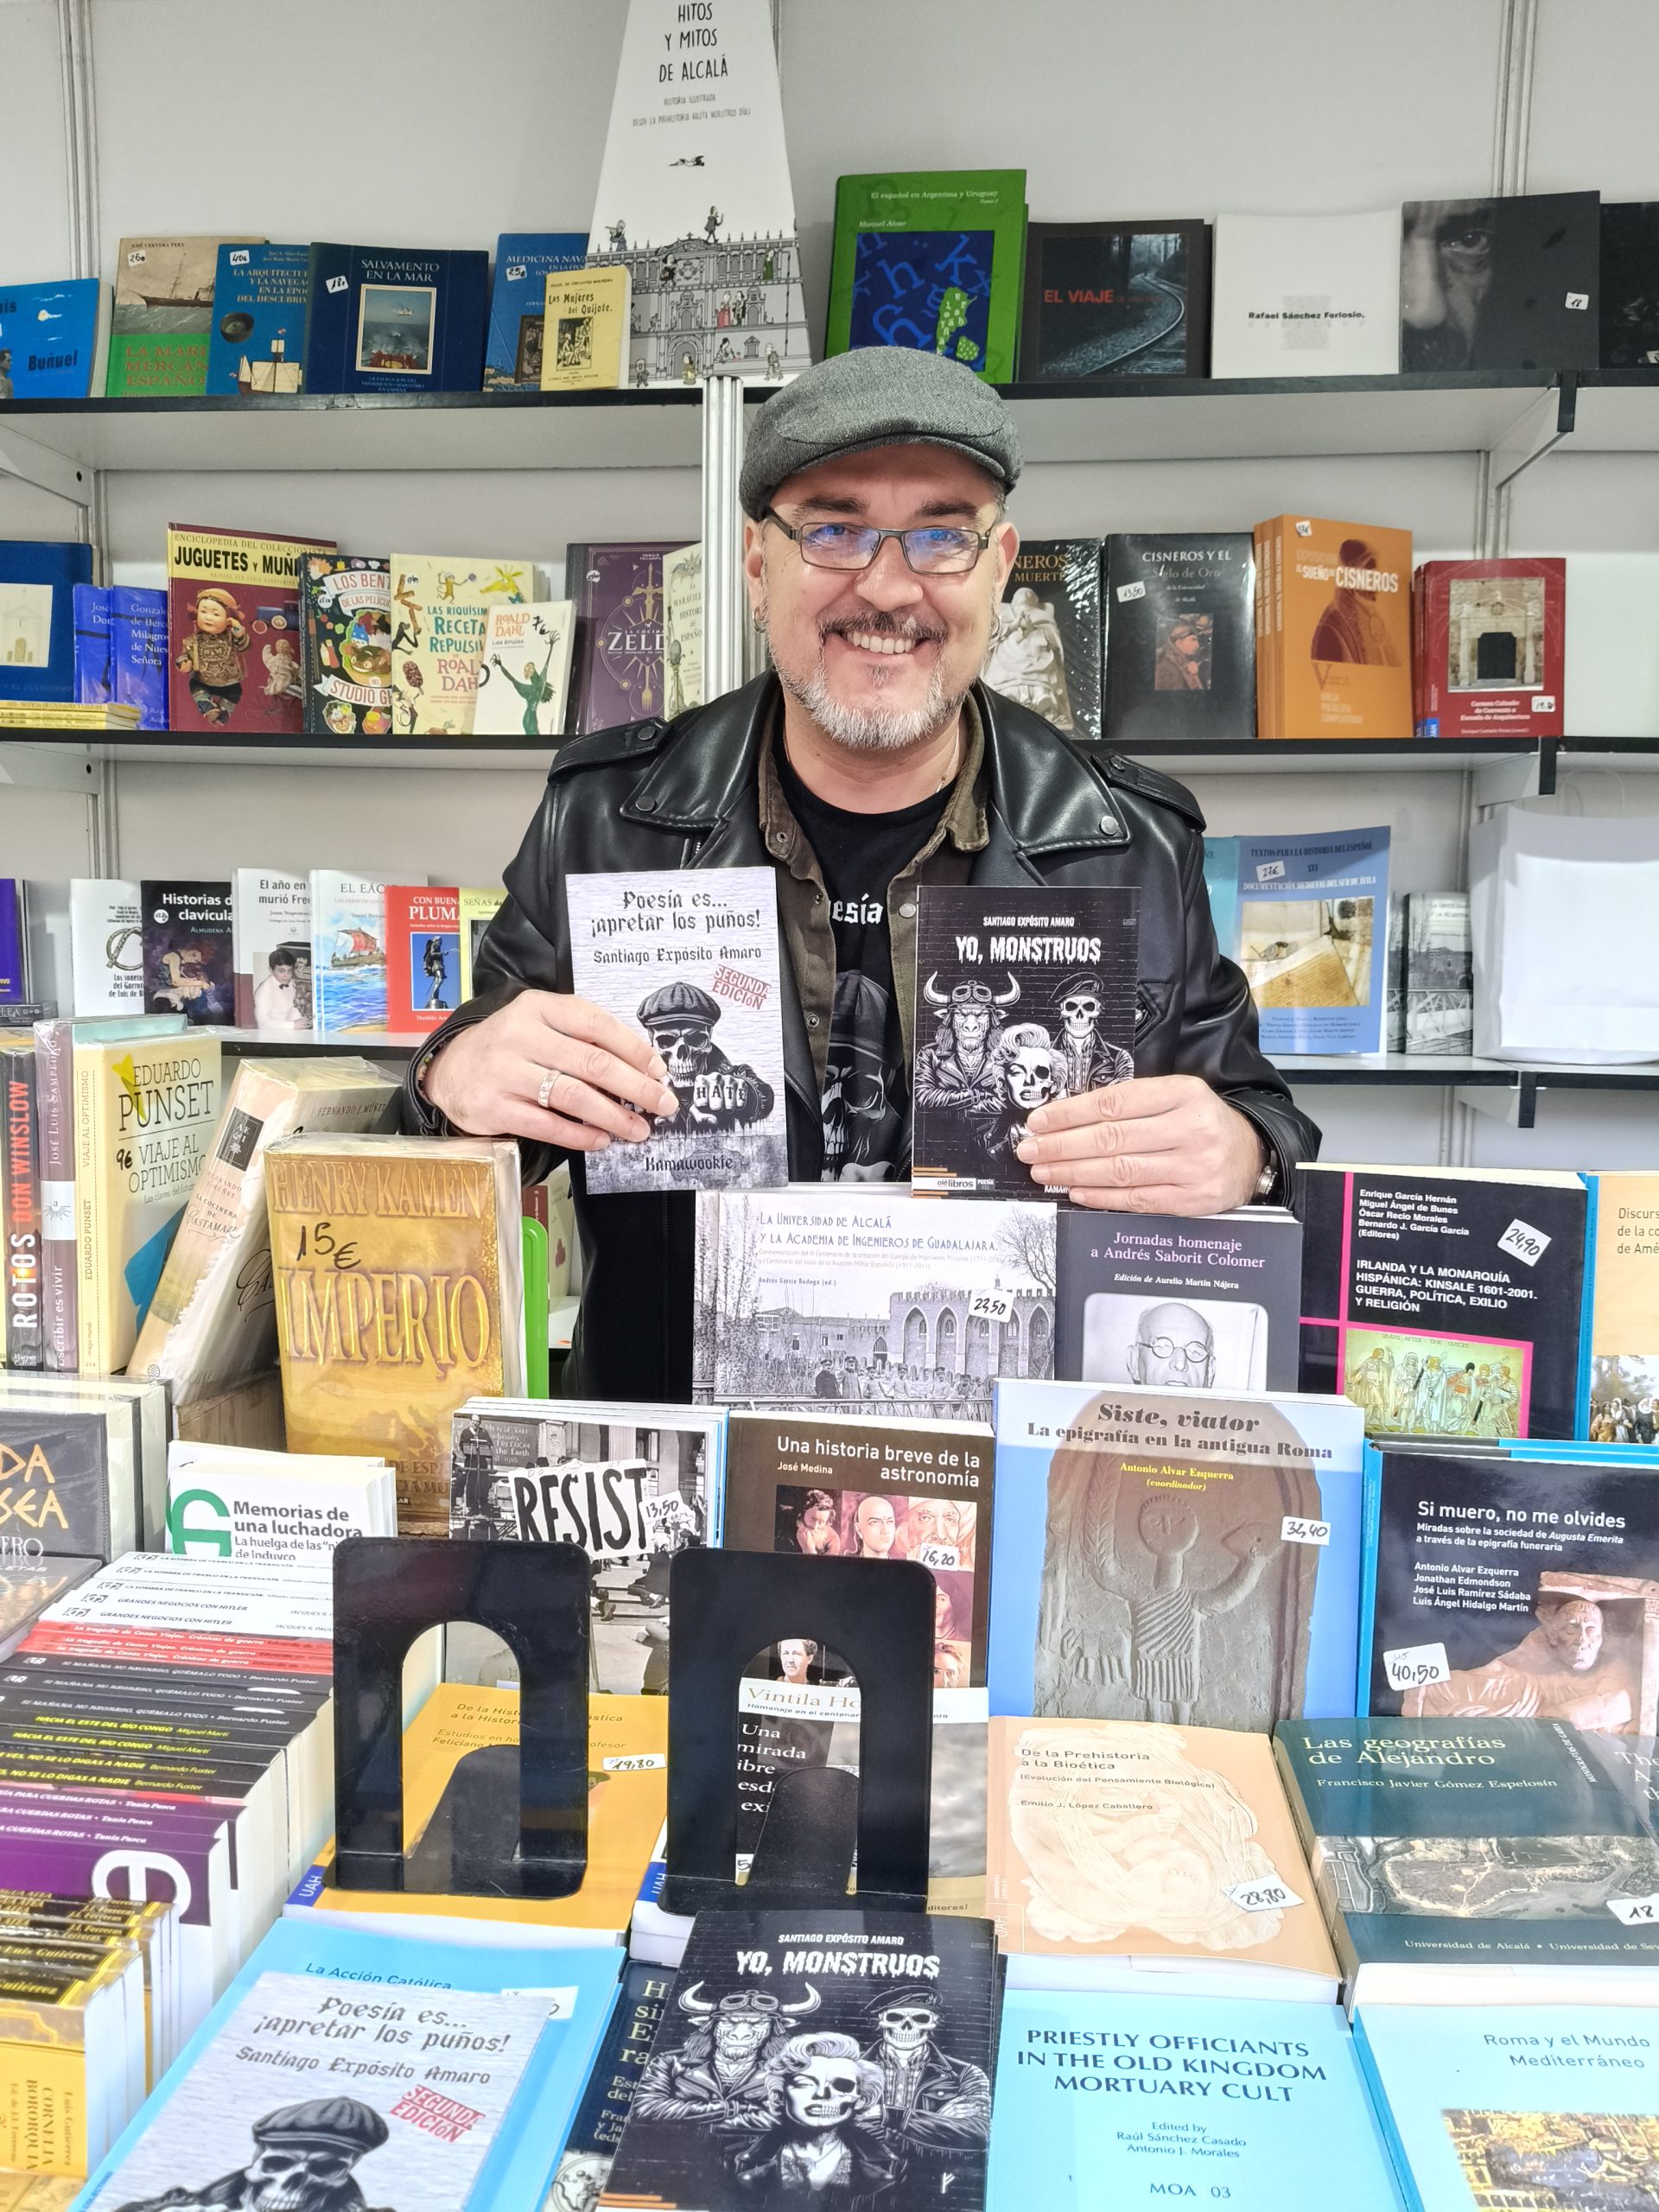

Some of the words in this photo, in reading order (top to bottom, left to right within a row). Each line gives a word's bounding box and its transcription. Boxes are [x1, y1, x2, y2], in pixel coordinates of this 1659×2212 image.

[678, 3, 712, 22] HITOS
[665, 33, 671, 51] Y
[680, 29, 717, 48] MITOS
[659, 64, 673, 82] DE
[682, 54, 728, 81] ALCALÁ
[880, 191, 908, 200] español
[922, 190, 956, 200] Argentina
[966, 189, 998, 200] Uruguay
[361, 260, 440, 272] SALVAMENTO
[366, 270, 384, 280] EN
[388, 271, 404, 280] LA
[408, 272, 433, 282] MAR
[549, 294, 560, 304] Las
[563, 293, 594, 303] Mujeres
[1045, 290, 1064, 303] EL
[1068, 289, 1114, 304] VIAJE
[1282, 310, 1320, 320] Sánchez
[28, 350, 77, 372] Buñuel
[174, 547, 248, 573] JUGUETES
[253, 563, 257, 572] Y
[1142, 552, 1203, 563] CISNEROS
[1207, 552, 1215, 561] Y
[1218, 550, 1231, 561] EL
[1154, 568, 1179, 580] Siglo
[1182, 569, 1194, 578] de
[1198, 567, 1220, 578] Oro
[495, 613, 530, 626] ROALD
[494, 624, 524, 638] DAHL
[1262, 866, 1279, 876] 27€
[260, 880, 268, 889] El
[271, 880, 290, 890] año
[623, 891, 683, 909] Poesía
[692, 893, 727, 907] es...
[830, 893, 883, 925] esía
[592, 914, 664, 938] ¡apretar
[672, 912, 696, 930] los
[706, 909, 760, 933] puños!
[983, 917, 1015, 928] SANTIAGO
[1018, 914, 1049, 927] EXPÓSITO
[1051, 917, 1074, 927] AMARO
[594, 949, 650, 965] Santiago
[657, 947, 712, 966] Expósito
[720, 946, 761, 959] Amaro
[956, 937, 983, 964] YO,
[990, 937, 1102, 964] MONSTRUOS
[714, 965, 771, 995] SEGUNDA
[712, 982, 763, 1010] EDICIÓN
[133, 1058, 200, 1087] EDUARDO
[696, 1087, 747, 1101] HATE
[119, 1081, 214, 1131] PUNSET
[10, 1081, 30, 1173] WINSLOW
[271, 1160, 370, 1216] HENRY
[376, 1162, 480, 1219] KAMEN
[13, 1180, 31, 1222] DON
[296, 1222, 361, 1269] 15€
[1114, 1232, 1173, 1247] Jornadas
[1179, 1236, 1242, 1253] homenaje
[1505, 1228, 1540, 1255] 24,90
[1103, 1248, 1150, 1261] Andrés
[1155, 1249, 1202, 1263] Saborit
[1207, 1254, 1265, 1268] Colomer
[11, 1233, 37, 1329] ROTOS
[1357, 1260, 1407, 1273] IRLANDA
[1408, 1262, 1417, 1273] Y
[1421, 1264, 1435, 1274] LA
[1438, 1265, 1510, 1283] MONARQUÍA
[1356, 1272, 1422, 1287] HISPÁNICA:
[1425, 1278, 1475, 1292] KINSALE
[1478, 1283, 1537, 1300] 1601-2001.
[1355, 1297, 1363, 1306] Y
[1366, 1298, 1421, 1312] RELIGIÓN
[1356, 1284, 1407, 1300] GUERRA,
[1410, 1287, 1466, 1306] POLÍTICA,
[1470, 1294, 1507, 1309] EXILIO
[277, 1266, 490, 1379] IMPERIO
[1098, 1402, 1167, 1428] Siste,
[1178, 1410, 1260, 1432] viator
[1027, 1422, 1050, 1437] La
[1056, 1426, 1140, 1446] epigrafía
[1145, 1433, 1167, 1446] en
[1174, 1433, 1192, 1448] la
[1198, 1438, 1270, 1456] antigua
[1278, 1443, 1332, 1459] Roma
[778, 1436, 810, 1453] Una
[816, 1440, 880, 1459] historia
[885, 1446, 933, 1464] breve
[938, 1450, 958, 1466] de
[965, 1452, 980, 1468] la
[880, 1467, 979, 1487] astronomía
[234, 1501, 321, 1522] Memorias
[327, 1503, 349, 1522] de
[514, 1468, 647, 1550] RESIST
[646, 1500, 678, 1517] 13,50
[1418, 1501, 1434, 1516] Si
[1440, 1504, 1500, 1522] muero,
[1507, 1509, 1527, 1522] no
[1532, 1510, 1559, 1523] me
[1564, 1511, 1625, 1528] olvides
[234, 1520, 266, 1535] una
[271, 1520, 362, 1537] luchadora
[922, 1549, 954, 1566] 16,20
[1391, 1665, 1440, 1683] 40,50
[748, 1688, 822, 1707] Vintila
[1302, 1737, 1351, 1750] Las
[1363, 1734, 1506, 1751] geografías
[612, 1758, 654, 1770] 19,80
[1054, 1761, 1116, 1770] Bioética
[1065, 1751, 1150, 1761] Prehistoria
[1309, 1751, 1342, 1764] de
[1356, 1751, 1496, 1768] Alejandro
[1317, 1779, 1384, 1788] Francisco
[1388, 1779, 1430, 1789] Javier
[1434, 1778, 1482, 1789] Gómez
[1489, 1779, 1557, 1789] Espelosín
[1240, 1888, 1286, 1905] 28,80
[778, 1934, 823, 1943] SANTIAGO
[826, 1934, 868, 1944] EXPÓSITO
[870, 1936, 904, 1946] AMARO
[736, 1951, 772, 1976] YO,
[783, 1951, 940, 1978] MONSTRUOS
[1027, 2030, 1140, 2048] PRIESTLY
[1149, 2035, 1310, 2056] OFFICIANTS
[1484, 2034, 1538, 2045] Roma
[1547, 2037, 1554, 2047] y
[1561, 2035, 1577, 2045] el
[1583, 2035, 1650, 2047] Mundo
[1018, 2051, 1046, 2066] IN
[1053, 2052, 1104, 2069] THE
[1113, 2055, 1172, 2071] OLD
[1183, 2058, 1326, 2081] KINGDOM
[1510, 2055, 1644, 2068] Mediterráneo
[1055, 2075, 1211, 2096] MORTUARY
[1222, 2082, 1293, 2102] CULT
